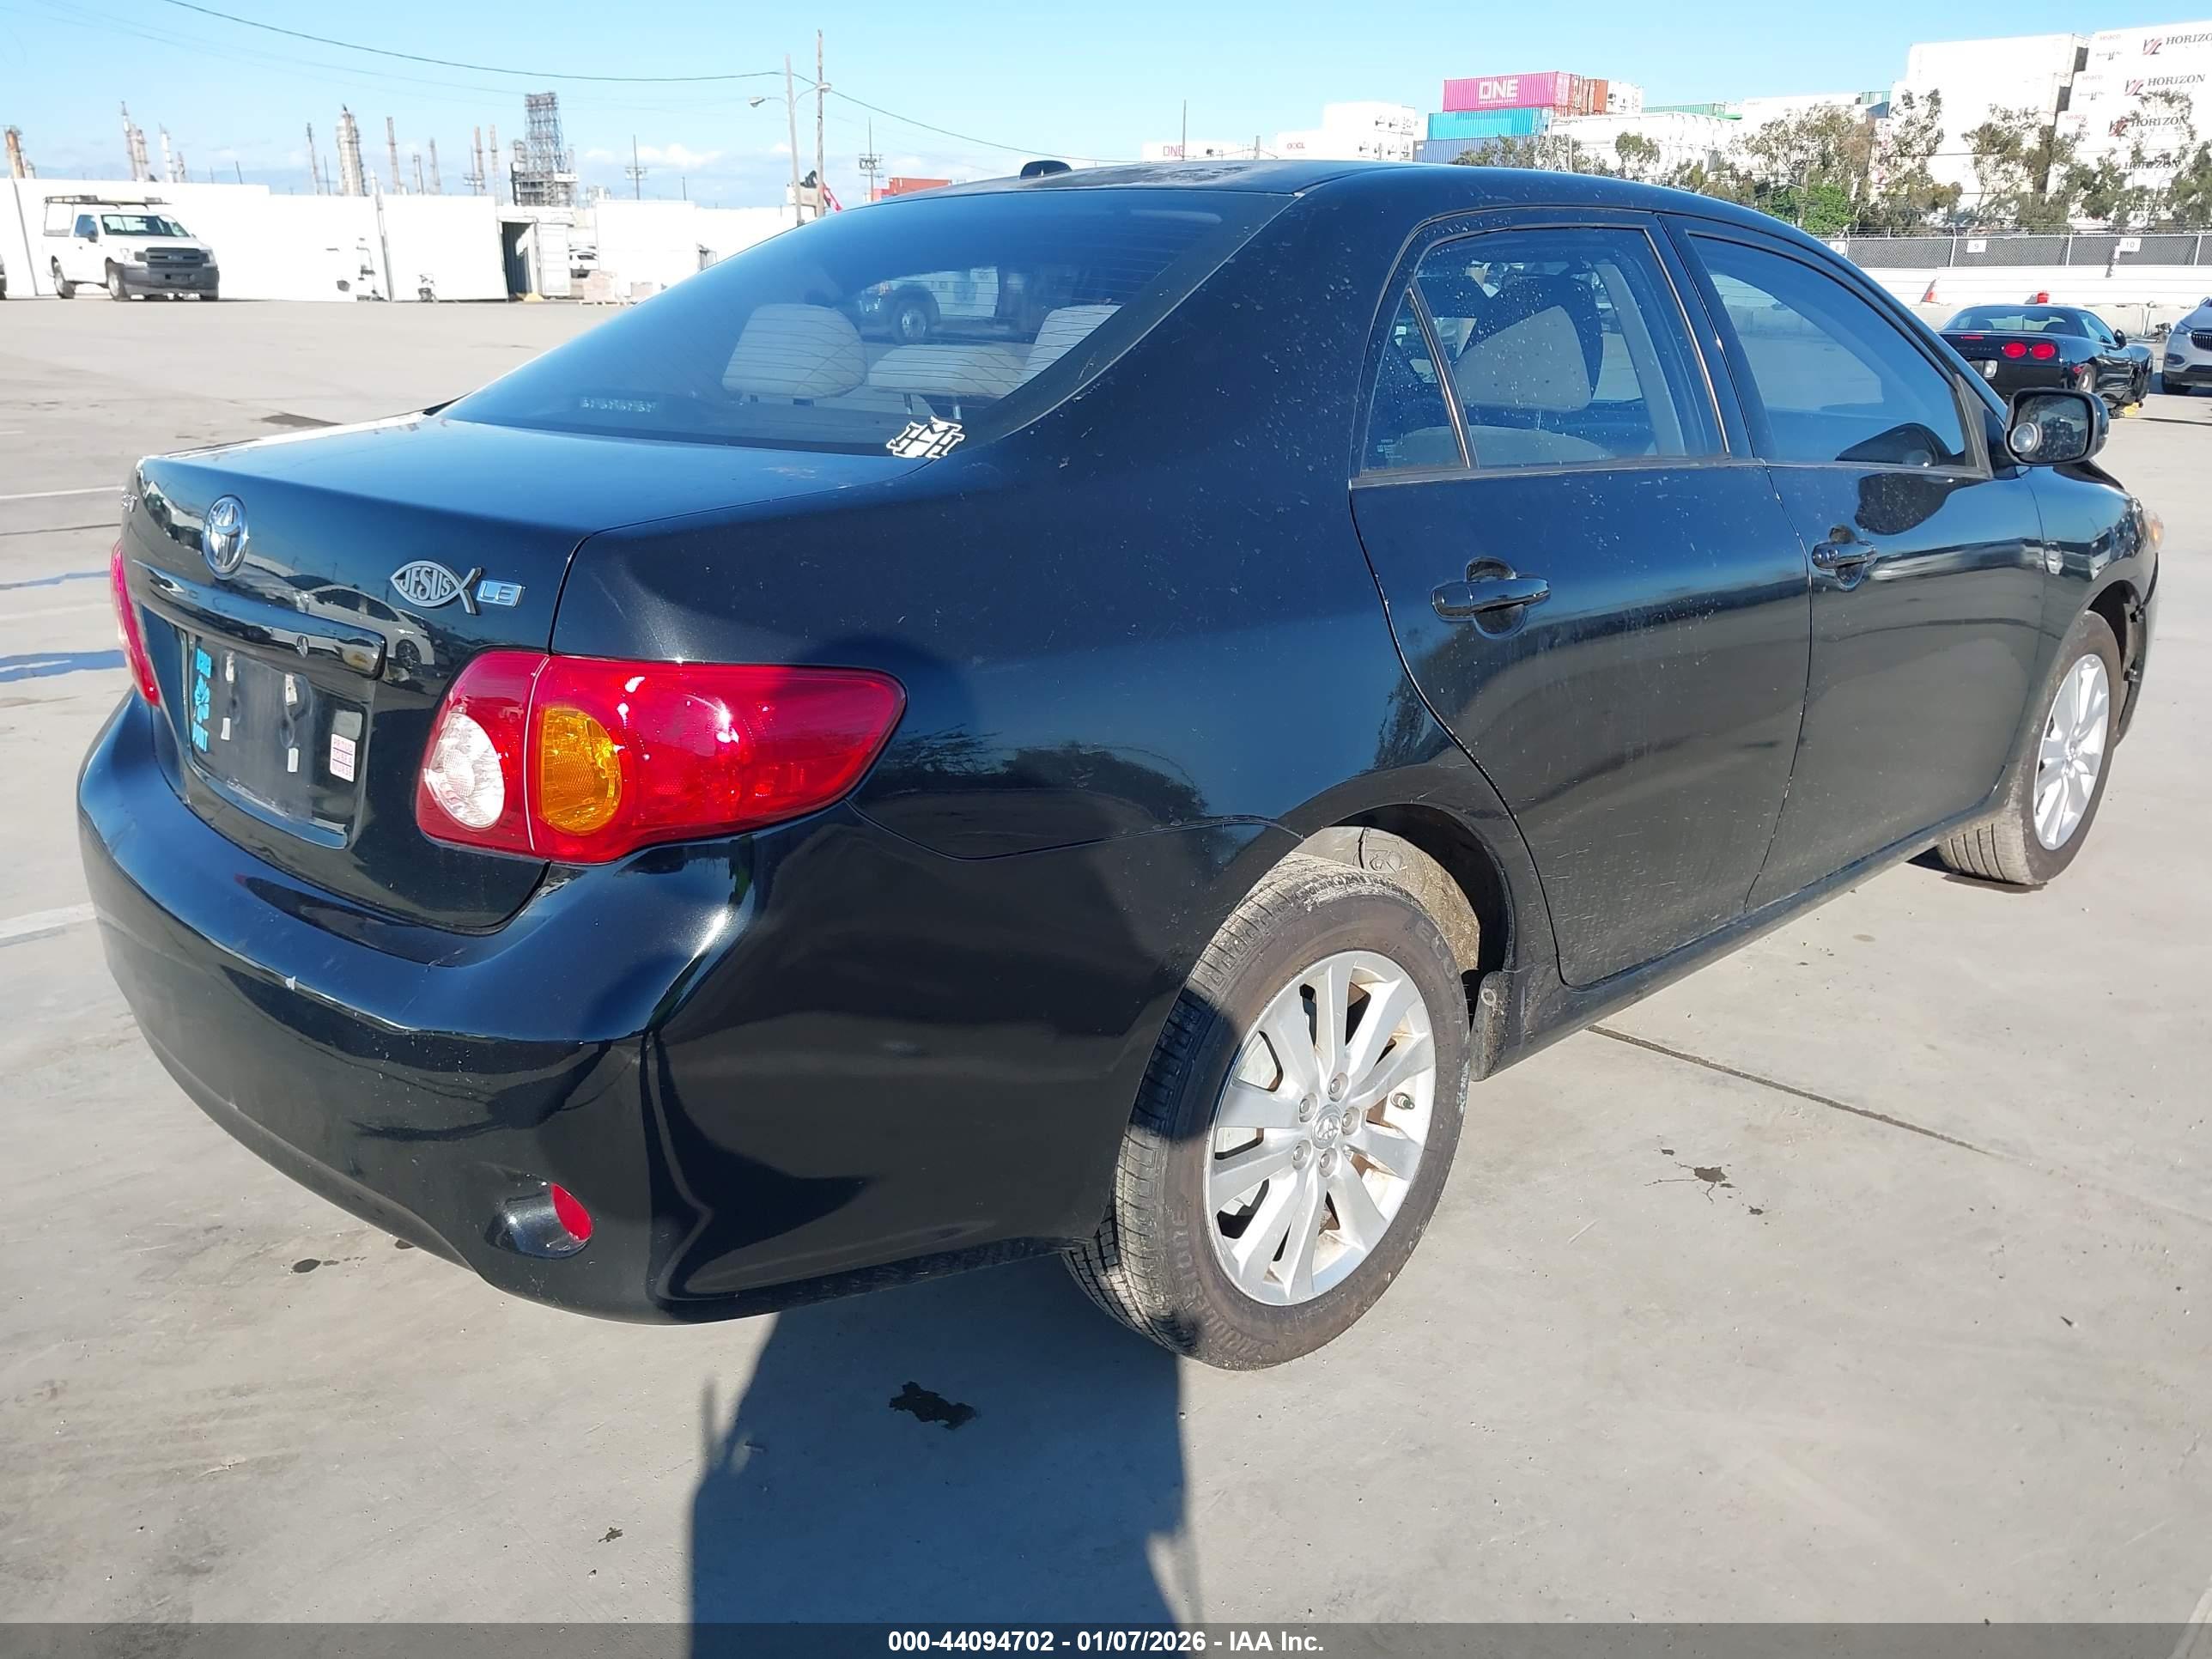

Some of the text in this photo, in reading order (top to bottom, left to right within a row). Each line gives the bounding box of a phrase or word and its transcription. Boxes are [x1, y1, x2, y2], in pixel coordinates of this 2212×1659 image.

[1479, 79, 1518, 100] ONE
[2148, 74, 2206, 87] HORIZON
[2130, 117, 2187, 127] HORIZON
[400, 566, 452, 600] JESUS
[480, 582, 514, 603] LE
